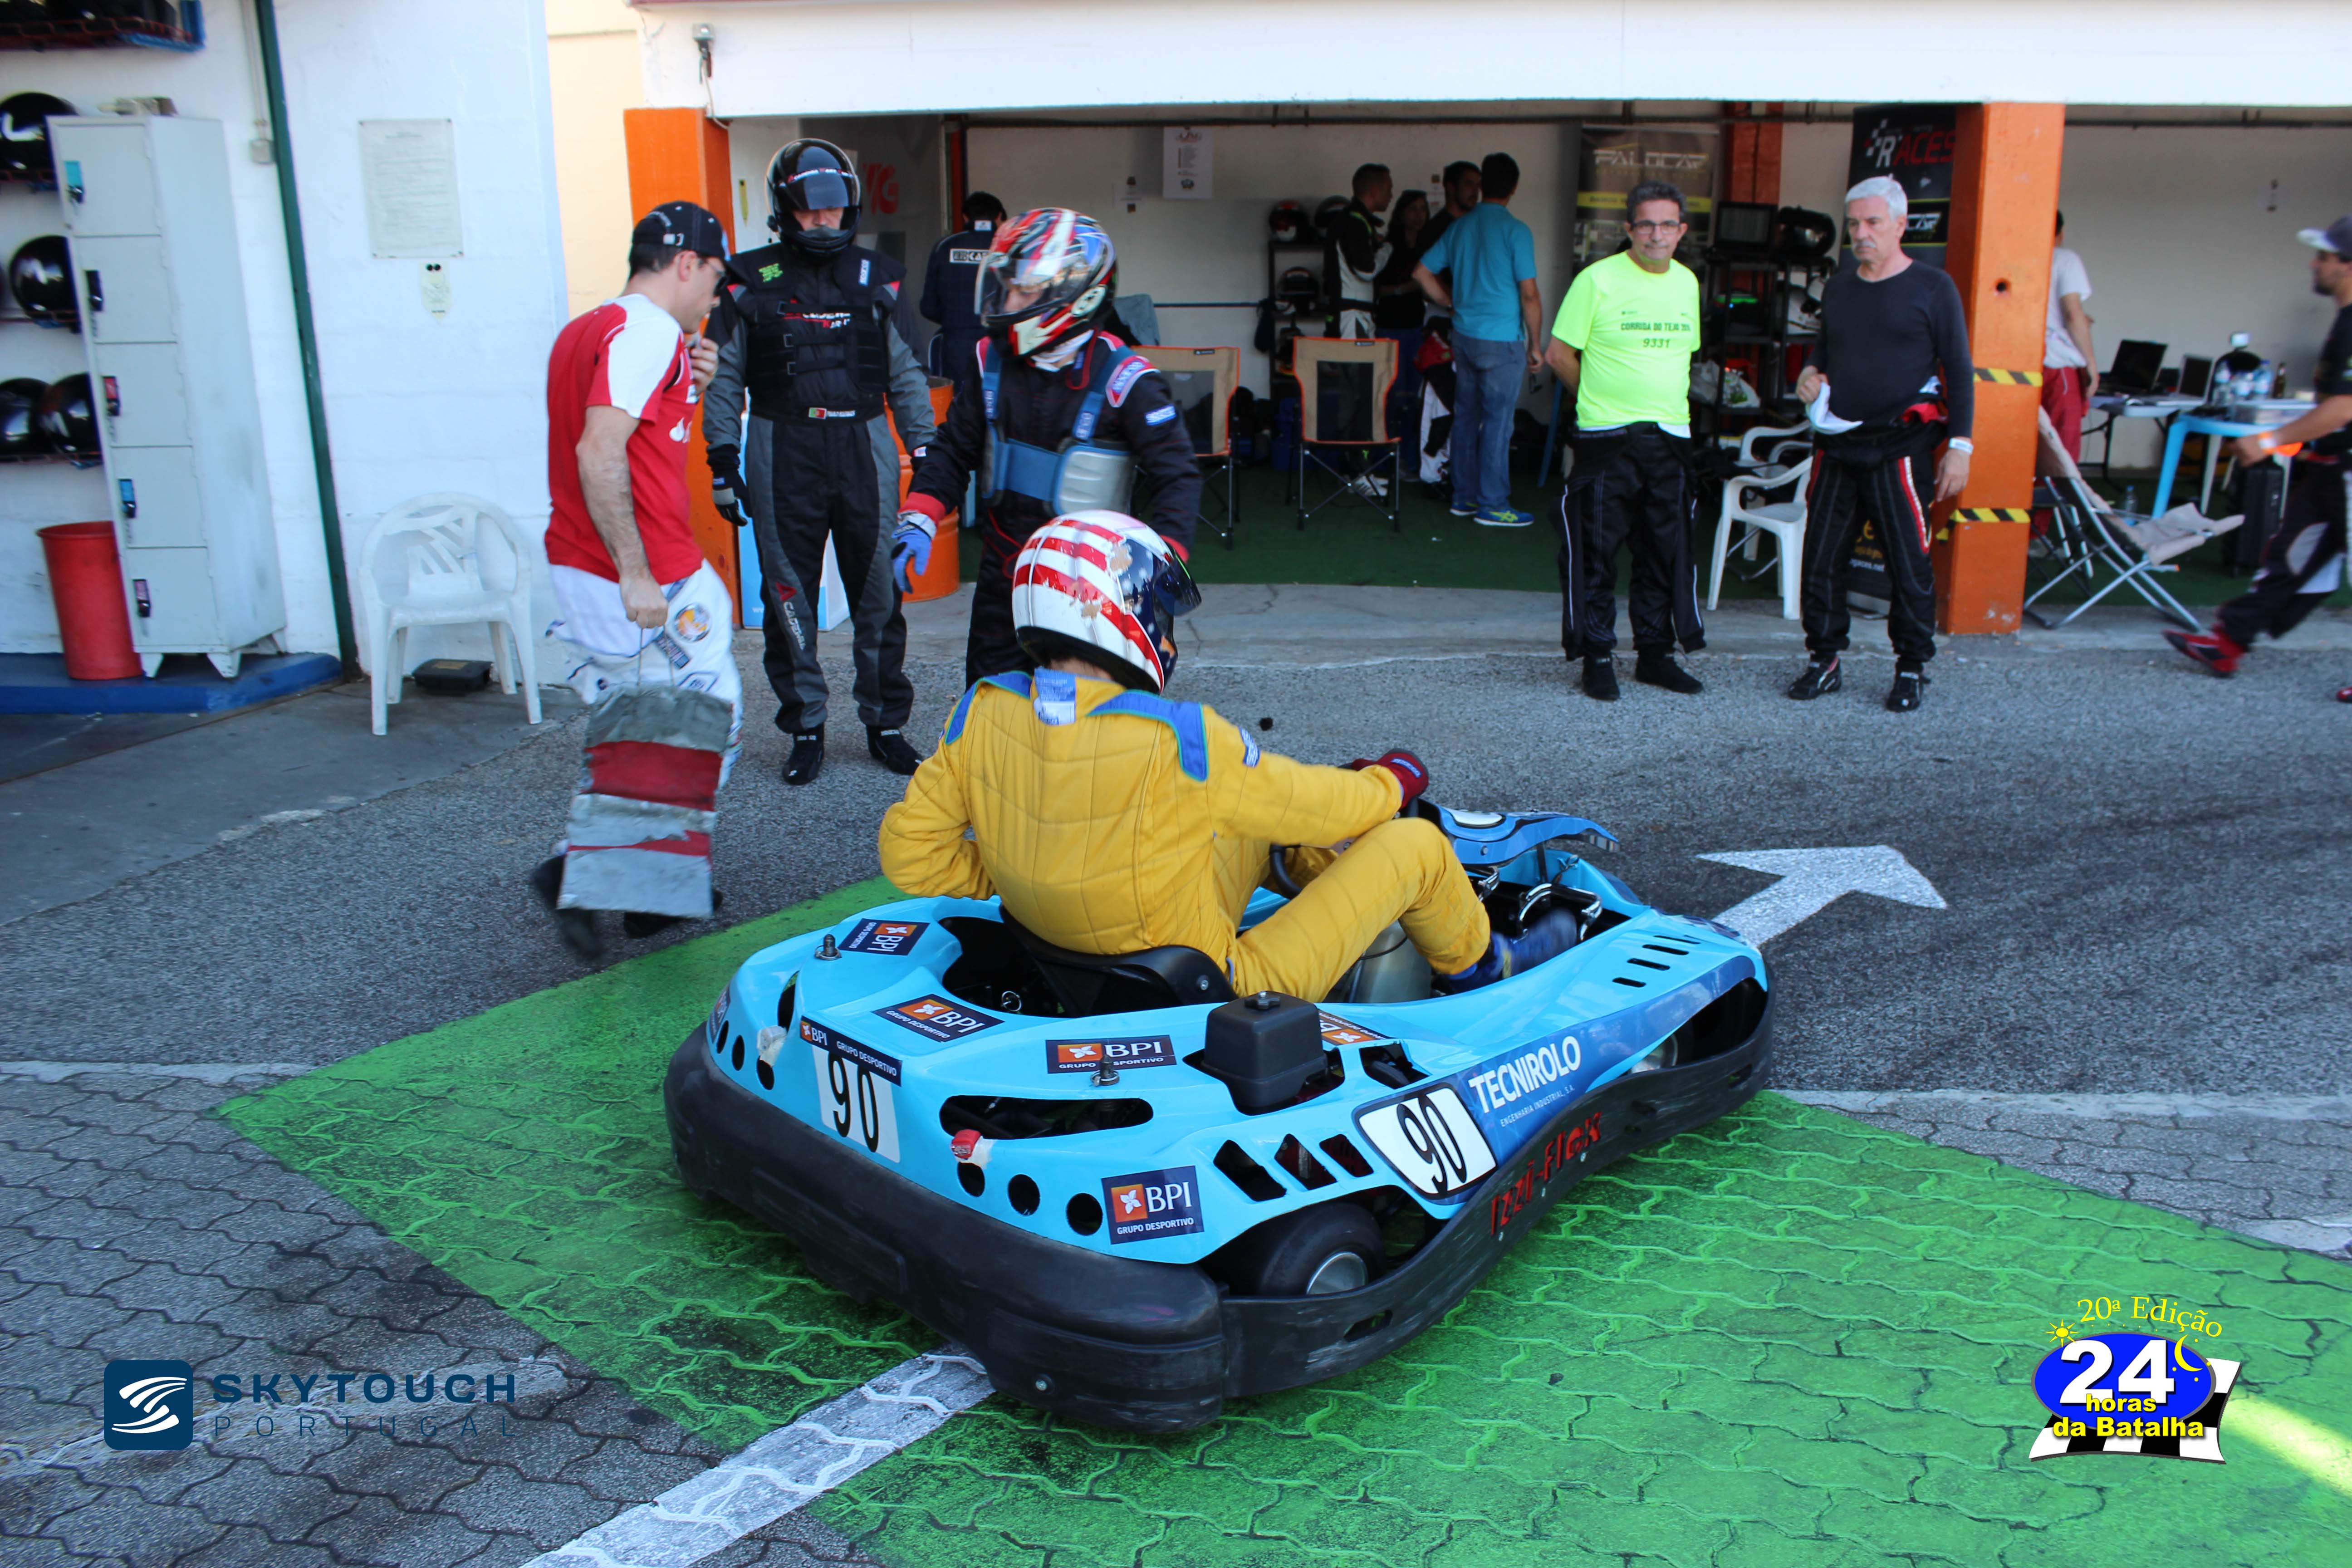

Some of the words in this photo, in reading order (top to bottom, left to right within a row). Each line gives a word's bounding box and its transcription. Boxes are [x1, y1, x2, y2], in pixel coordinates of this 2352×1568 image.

[1642, 338, 1671, 348] 9331
[867, 934, 904, 952] BPI
[886, 1010, 911, 1022] GRUPO
[908, 1020, 951, 1039] DESPORTIVO
[929, 1011, 985, 1033] BPI
[811, 1027, 828, 1045] BPI
[836, 1041, 858, 1057] GRUPO
[858, 1051, 897, 1076] DESPORTIVO
[1105, 1041, 1162, 1058] BPI
[1112, 1057, 1164, 1066] SPORTIVO
[1468, 1035, 1581, 1113] TECNIROLO
[827, 1051, 879, 1153] 90
[1499, 1104, 1534, 1127] ENGENHARIA
[1396, 1093, 1467, 1194] 90
[1145, 1181, 1192, 1213] BPI
[1117, 1224, 1144, 1235] GRUPO
[1145, 1217, 1194, 1231] DESPORTIVO
